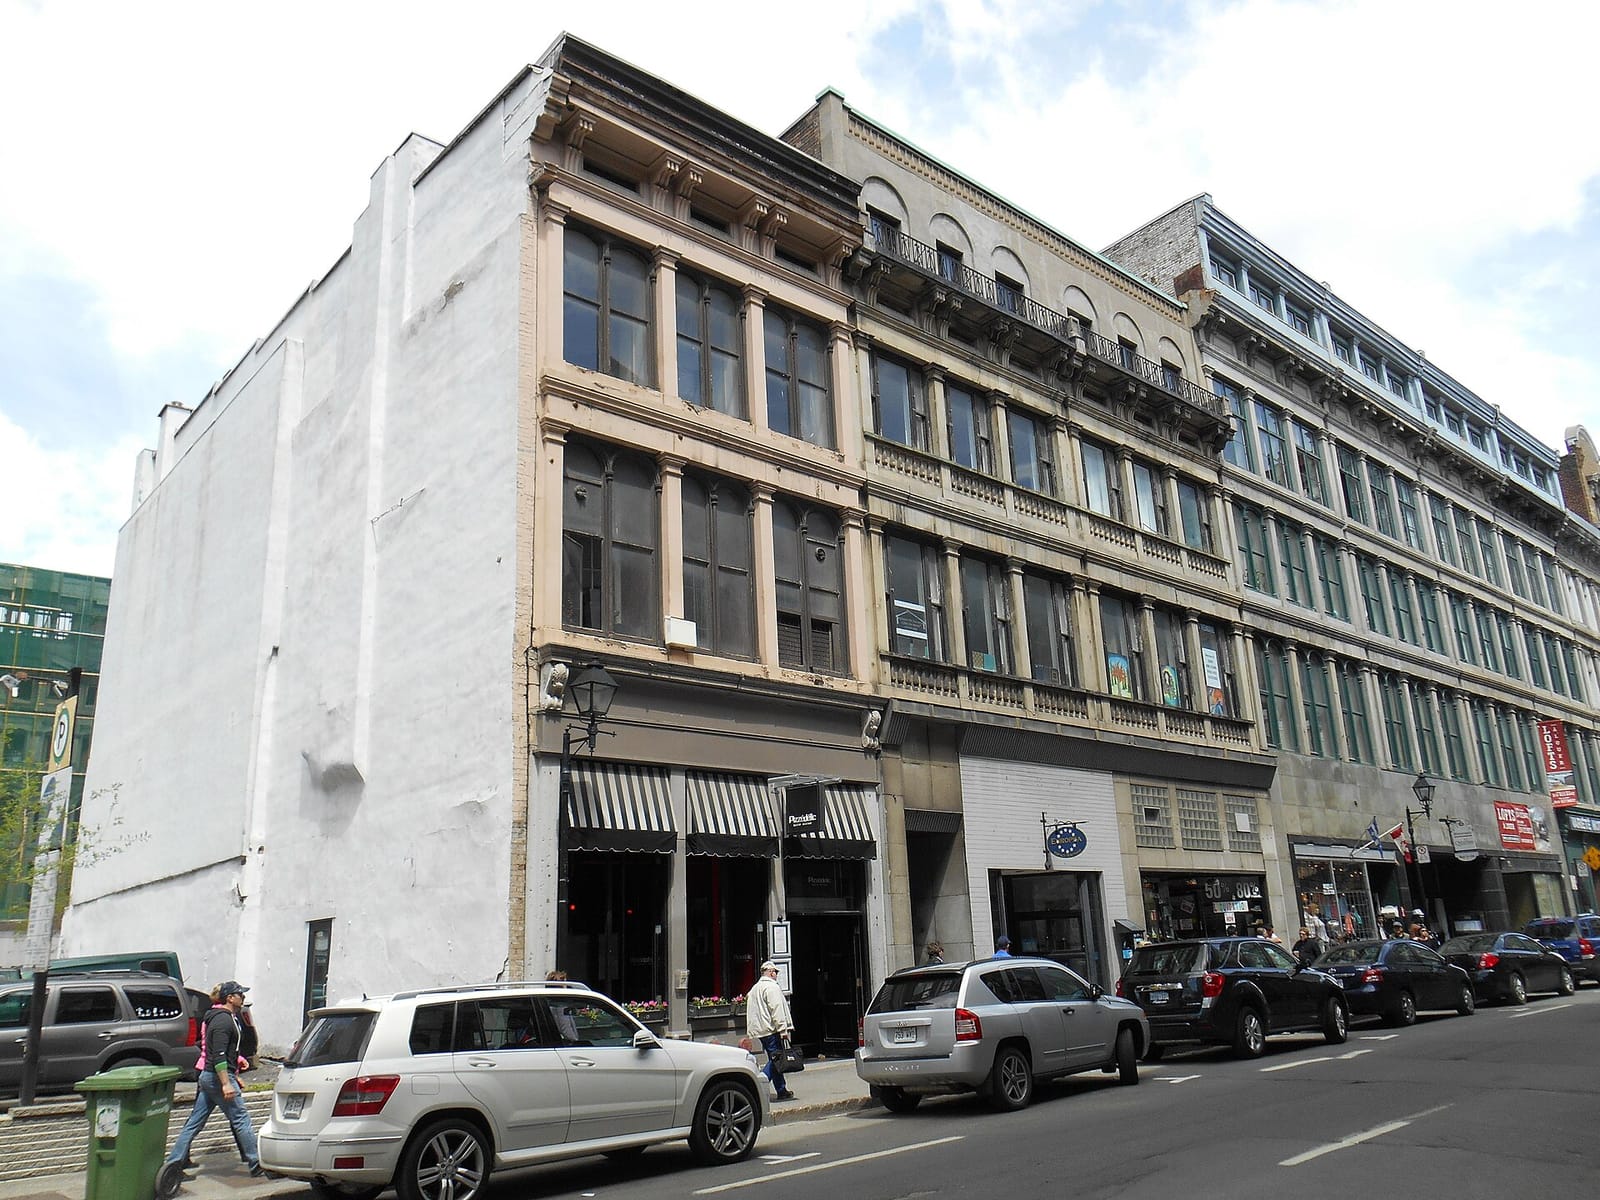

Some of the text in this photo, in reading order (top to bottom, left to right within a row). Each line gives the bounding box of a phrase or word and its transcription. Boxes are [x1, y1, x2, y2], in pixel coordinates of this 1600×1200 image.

[58, 721, 65, 750] P
[1542, 725, 1557, 770] LOFTS
[1496, 807, 1516, 822] LOFTS
